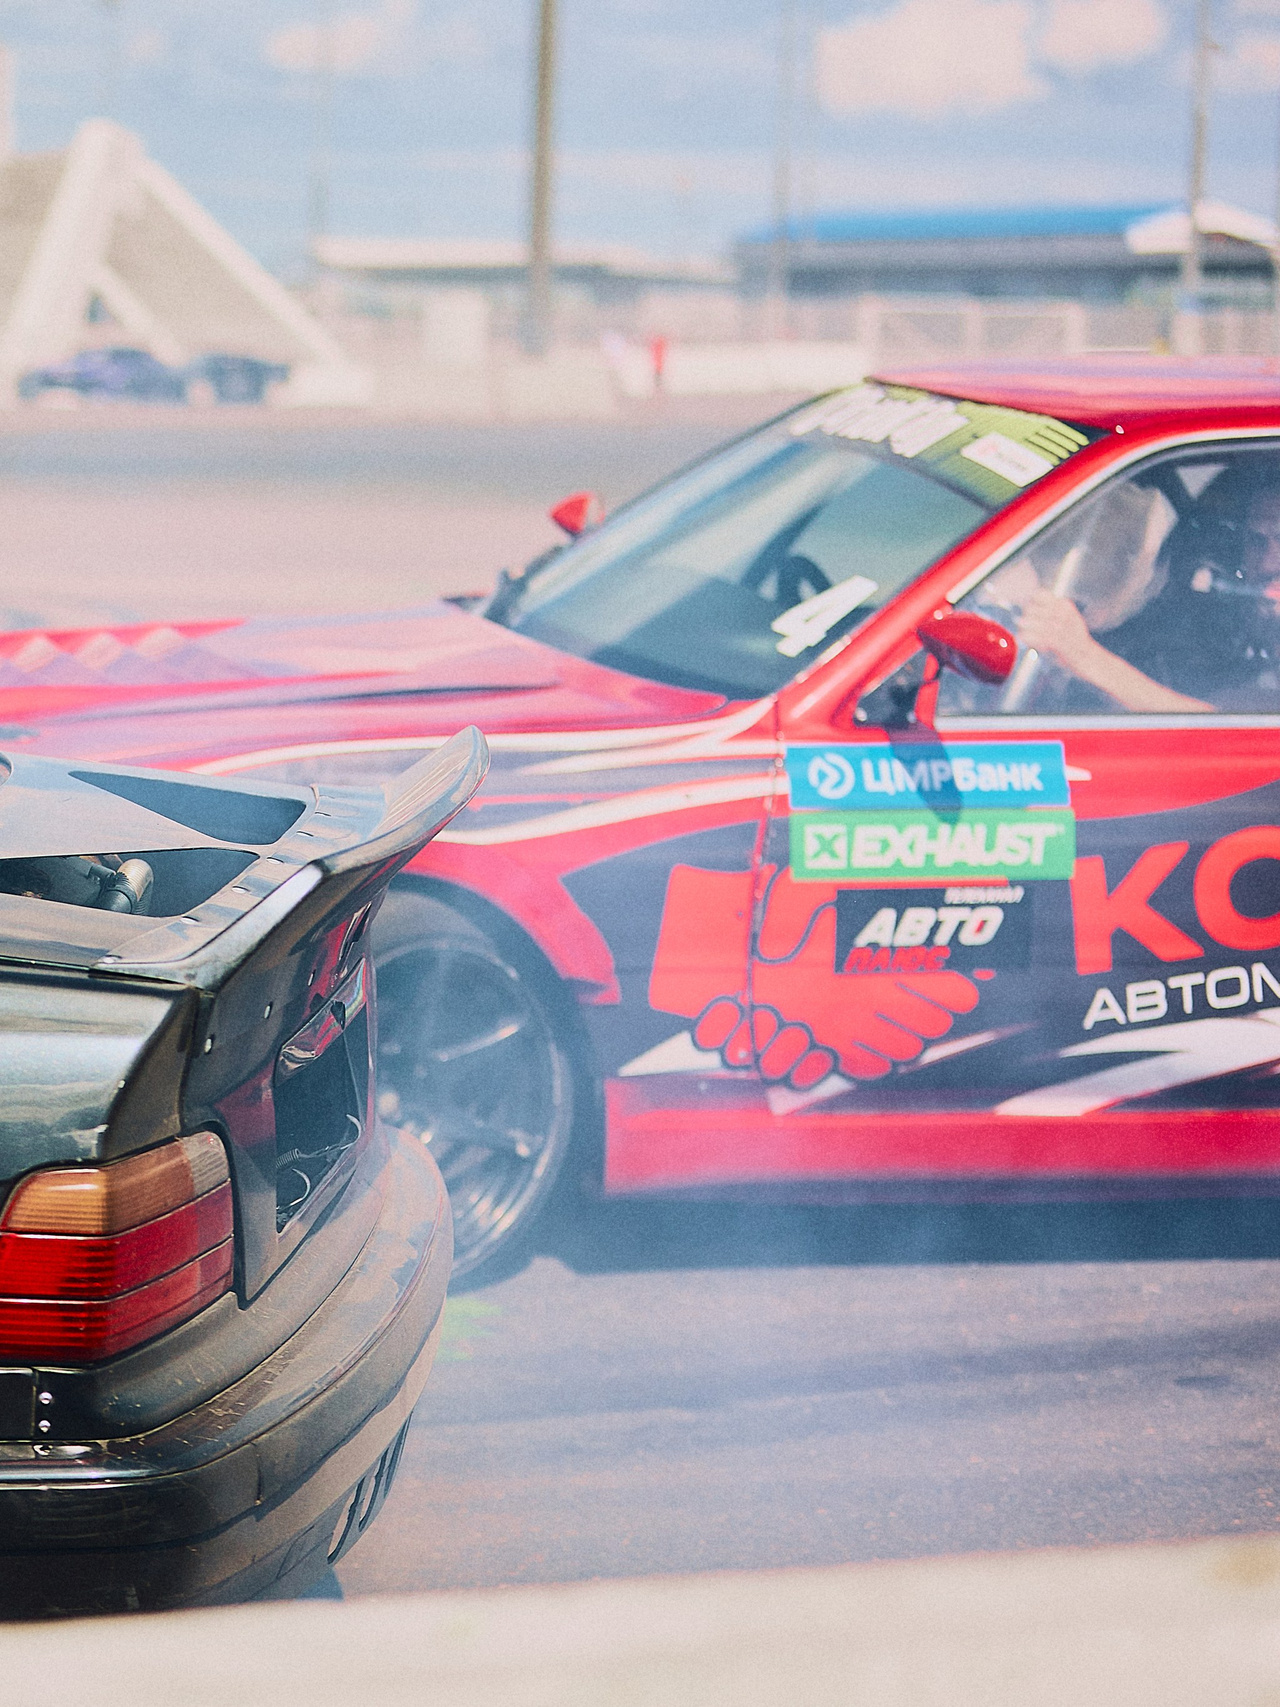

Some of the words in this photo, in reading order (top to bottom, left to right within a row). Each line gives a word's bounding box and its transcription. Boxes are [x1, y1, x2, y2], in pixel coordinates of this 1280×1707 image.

[861, 758, 1043, 795] ЦМРБанк
[851, 823, 1059, 867] EXHAUST
[853, 905, 1005, 947] АВТО
